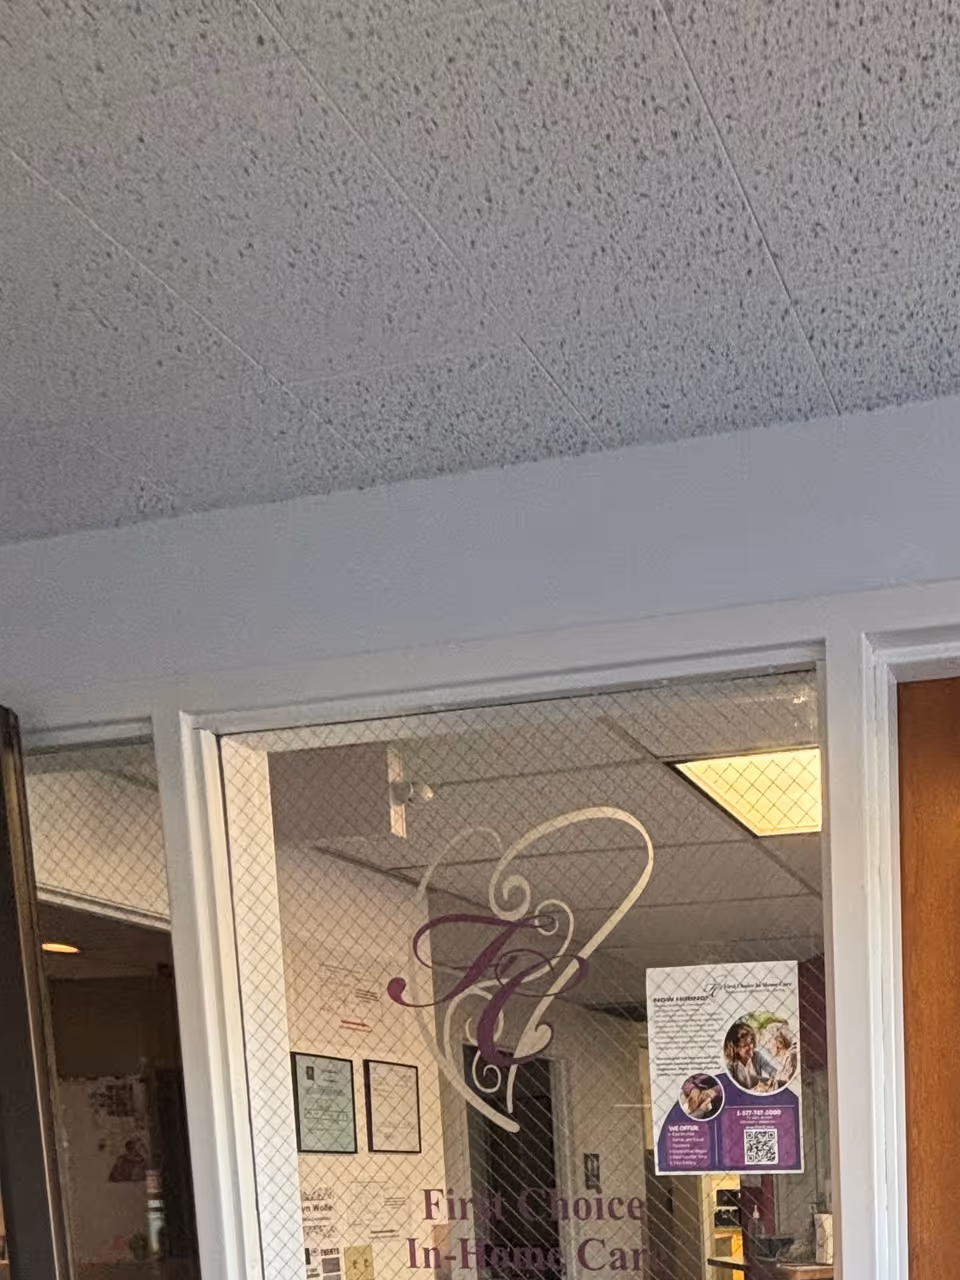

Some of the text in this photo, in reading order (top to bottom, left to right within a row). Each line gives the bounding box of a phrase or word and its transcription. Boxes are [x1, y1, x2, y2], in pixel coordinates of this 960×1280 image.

[652, 995, 675, 1003] NOW
[518, 1187, 644, 1221] Choice
[407, 1237, 564, 1270] In-Home
